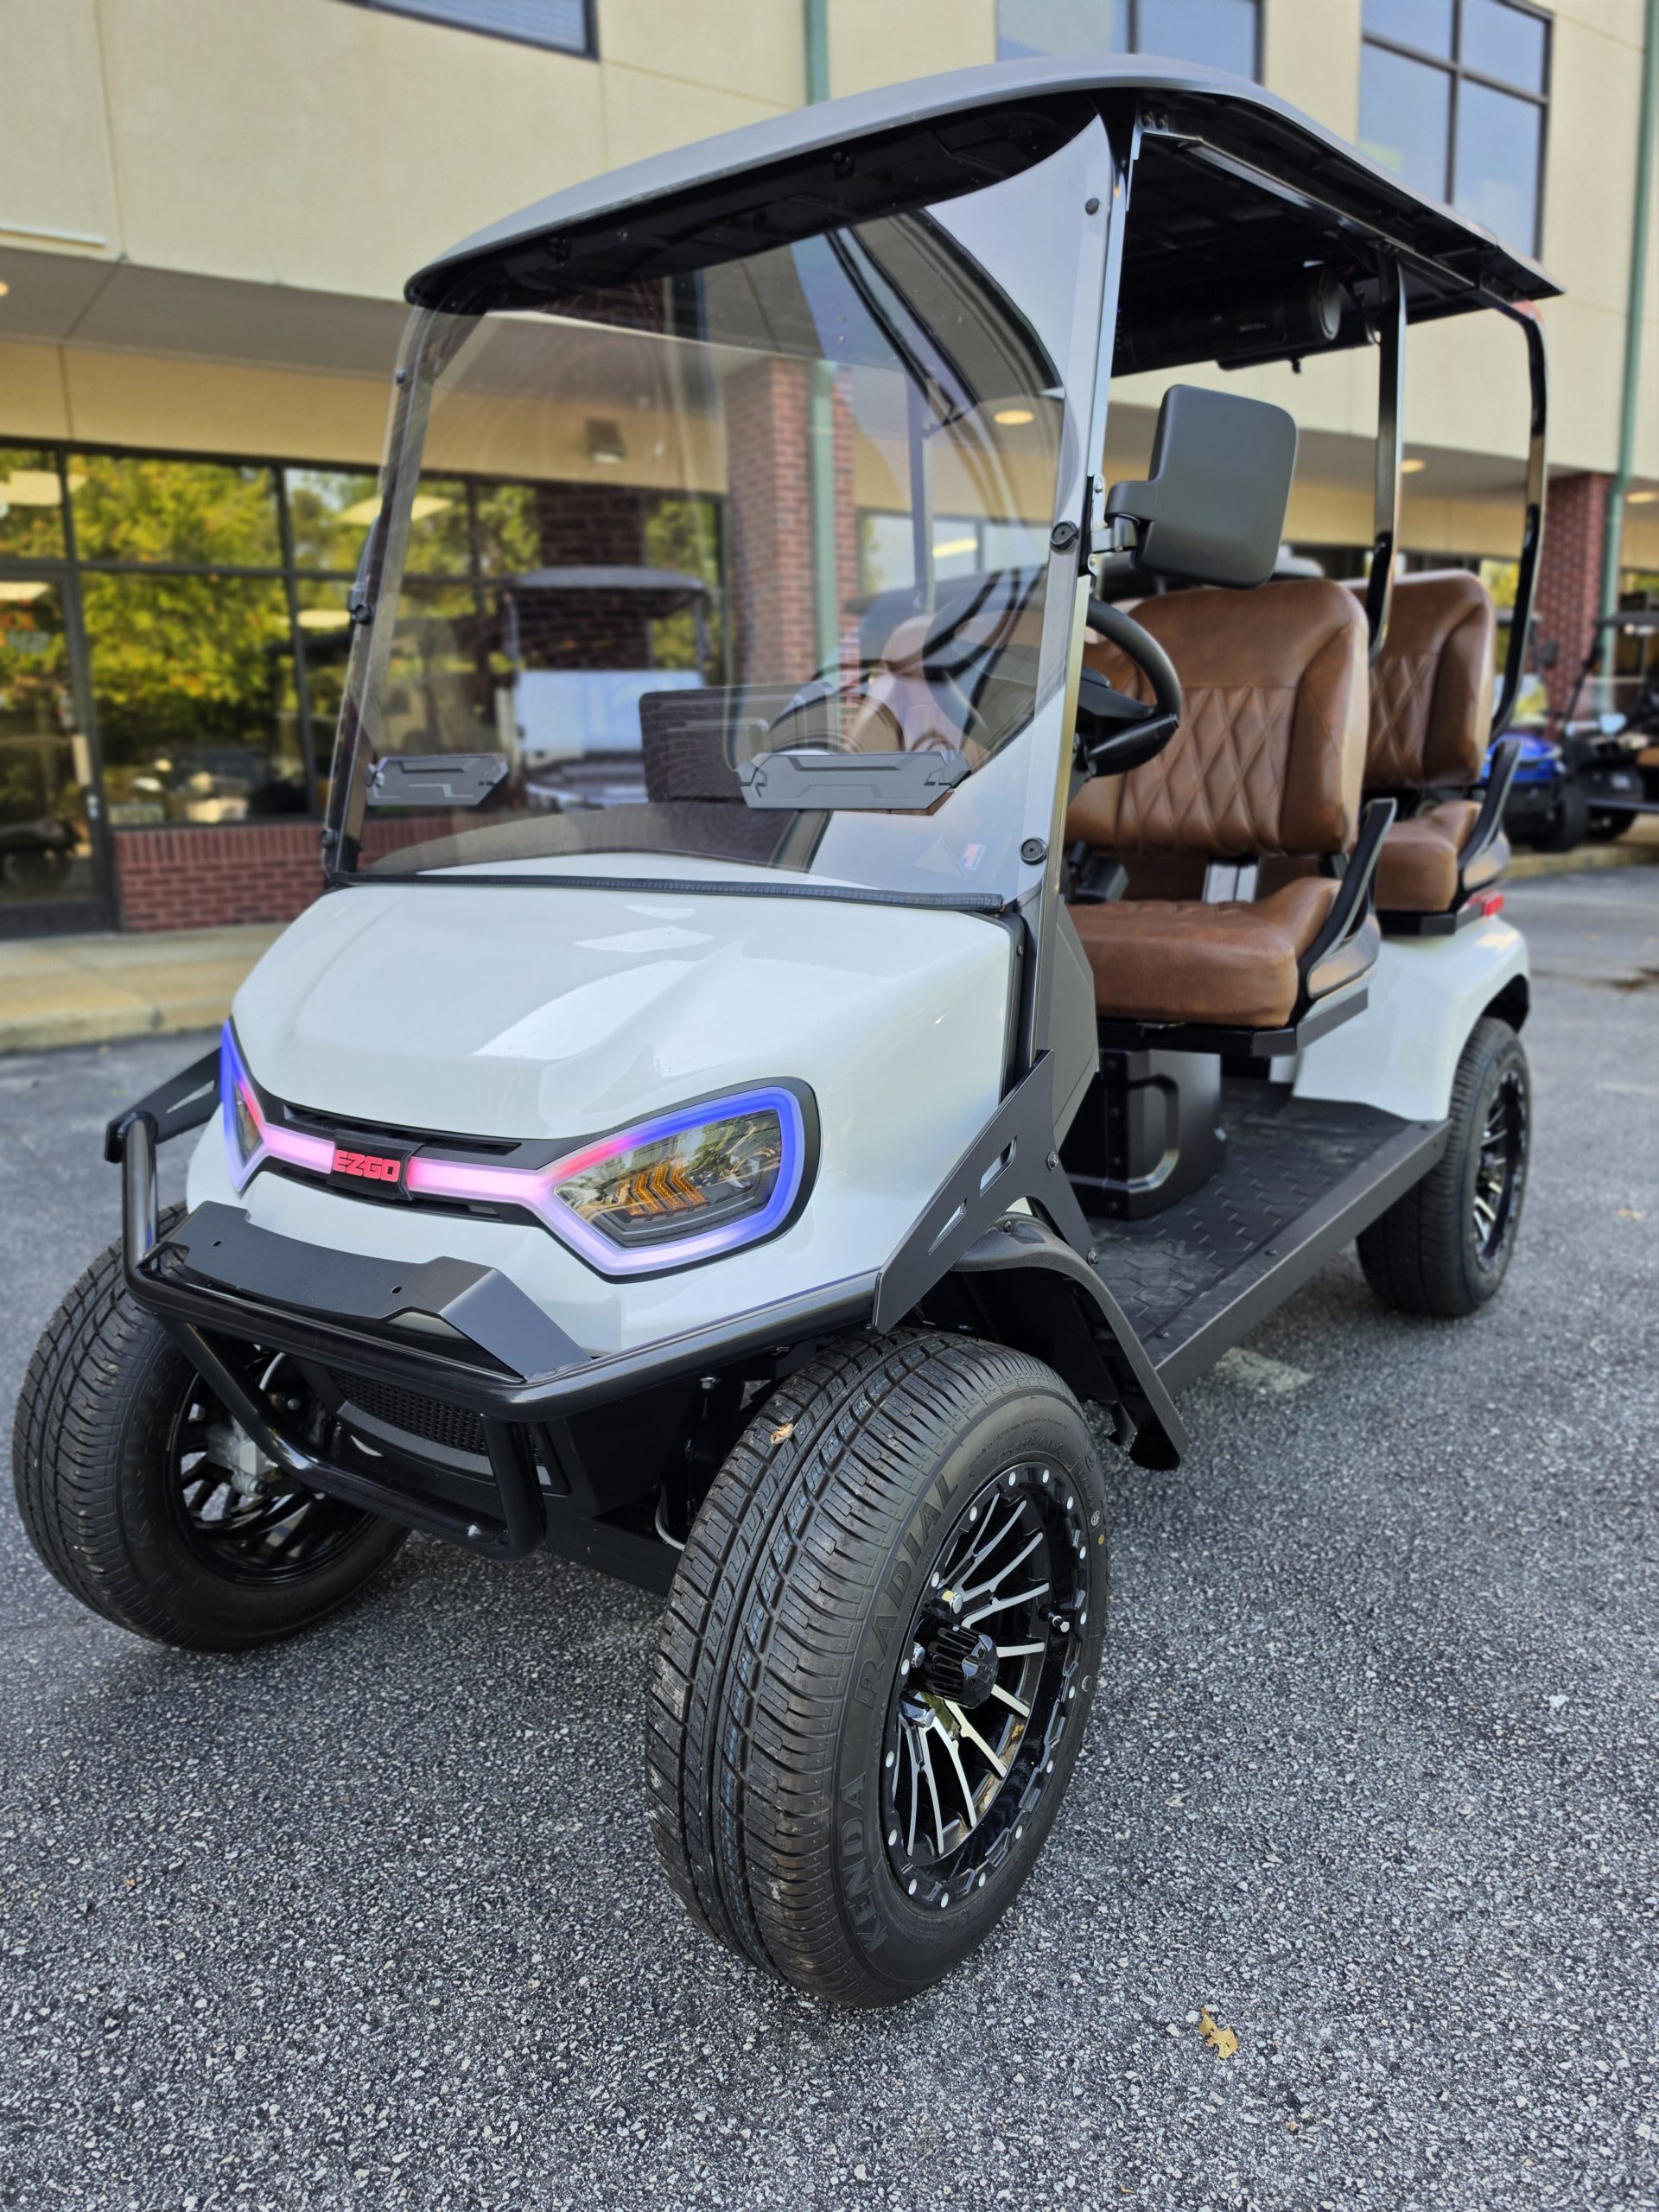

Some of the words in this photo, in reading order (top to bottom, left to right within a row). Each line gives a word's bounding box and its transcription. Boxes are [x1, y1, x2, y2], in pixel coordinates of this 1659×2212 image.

[333, 1150, 401, 1183] EZGO
[854, 1473, 958, 1709] RADIAL
[841, 1771, 890, 1954] KENDA
